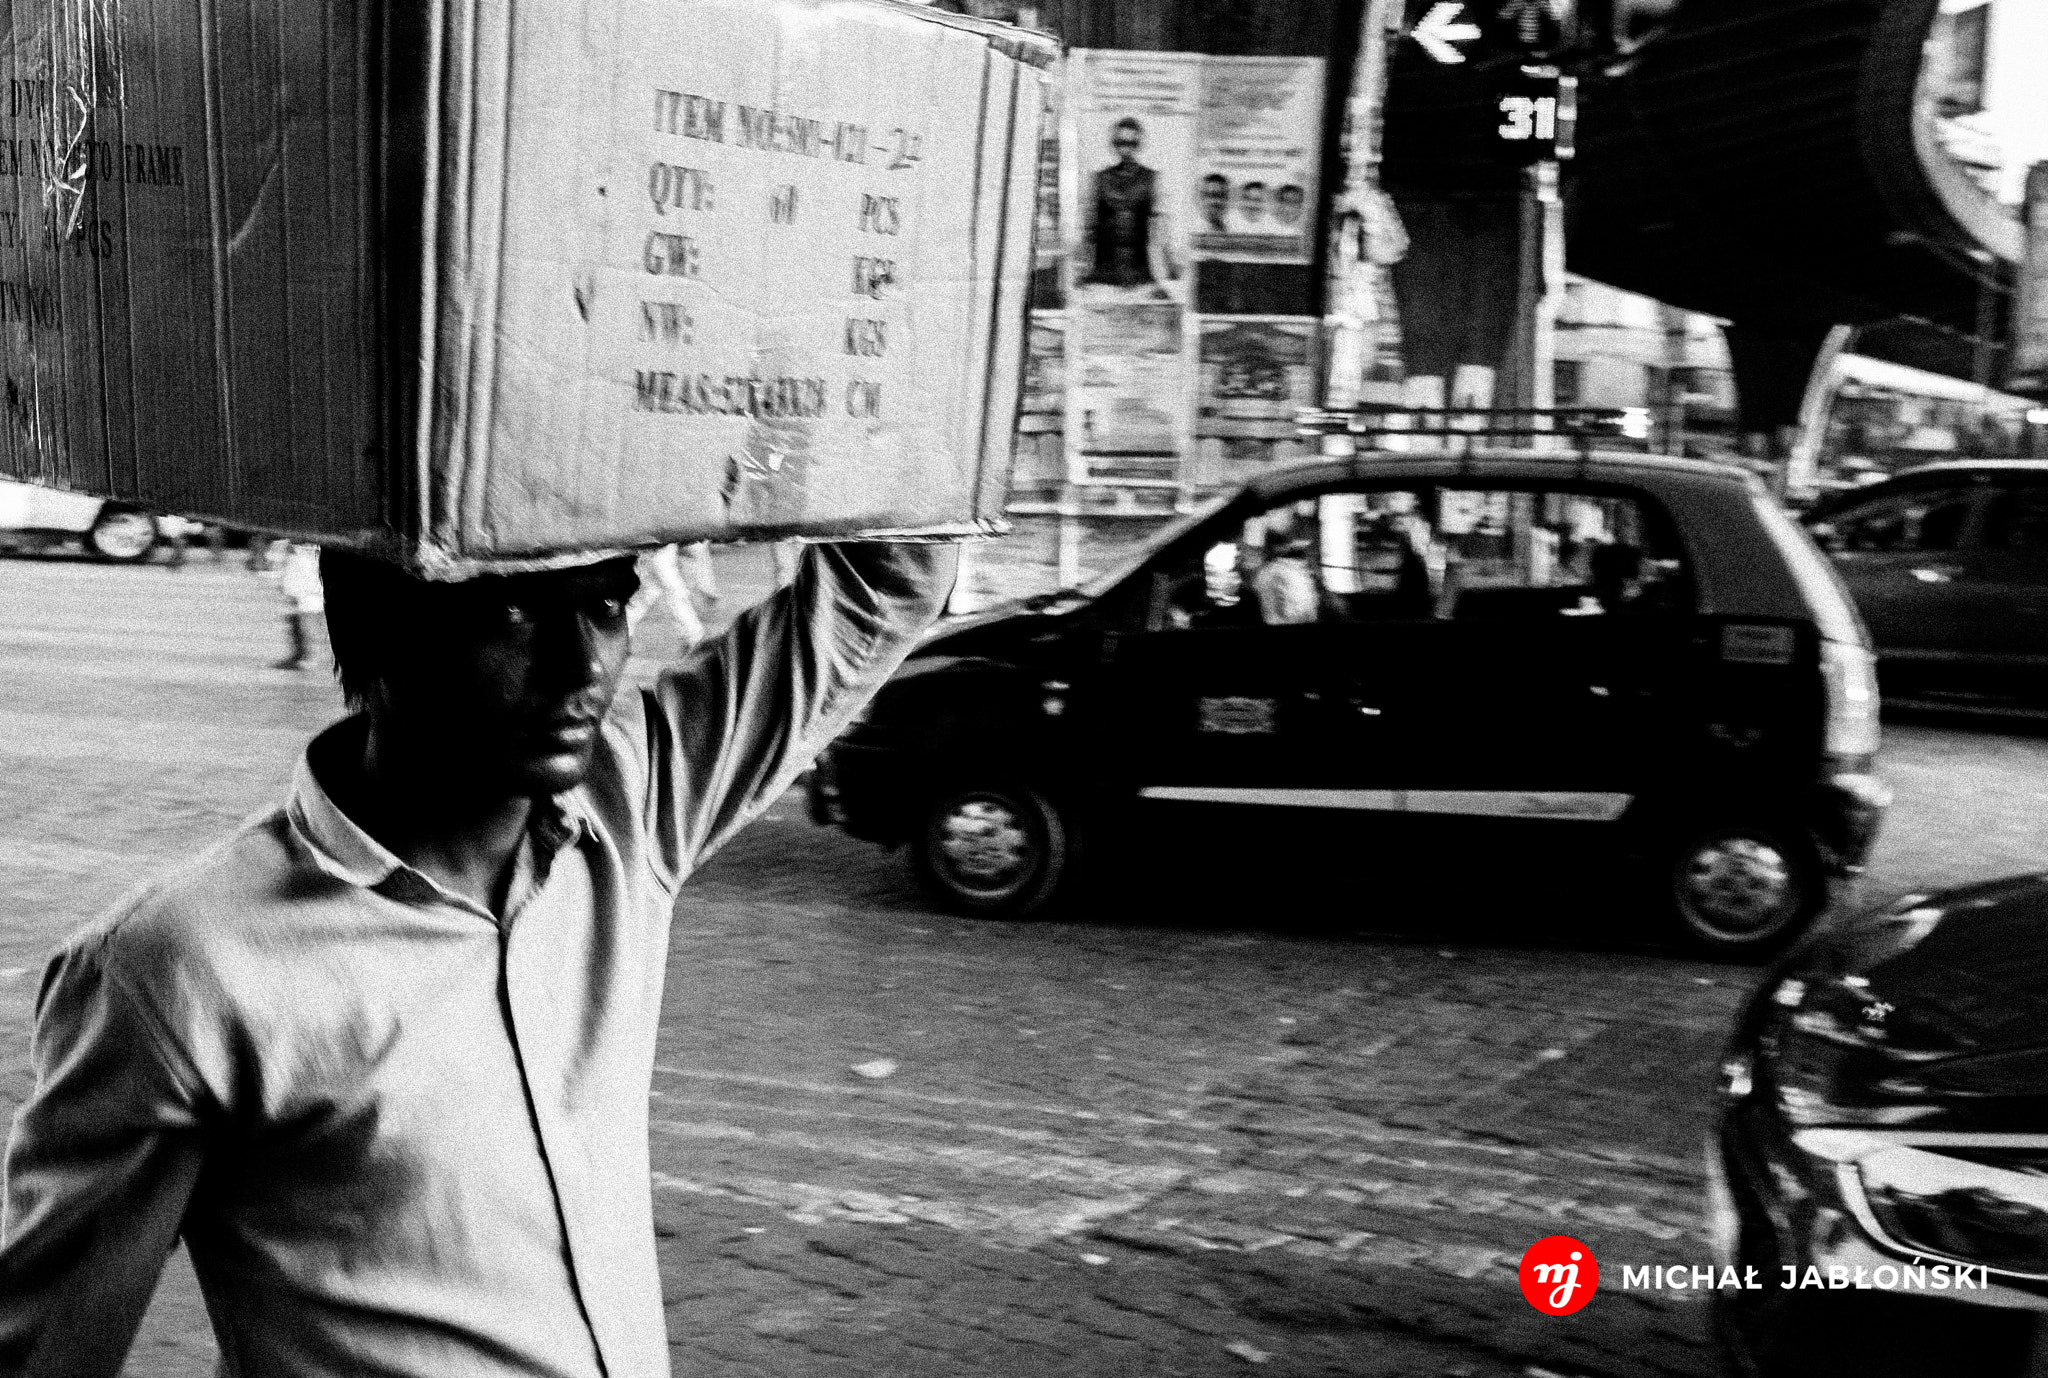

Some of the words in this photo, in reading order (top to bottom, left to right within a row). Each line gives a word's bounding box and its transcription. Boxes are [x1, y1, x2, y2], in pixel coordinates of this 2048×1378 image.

[653, 89, 725, 143] ITEM
[1499, 97, 1556, 139] 31
[124, 143, 184, 186] FRAME
[857, 192, 900, 236] PCS
